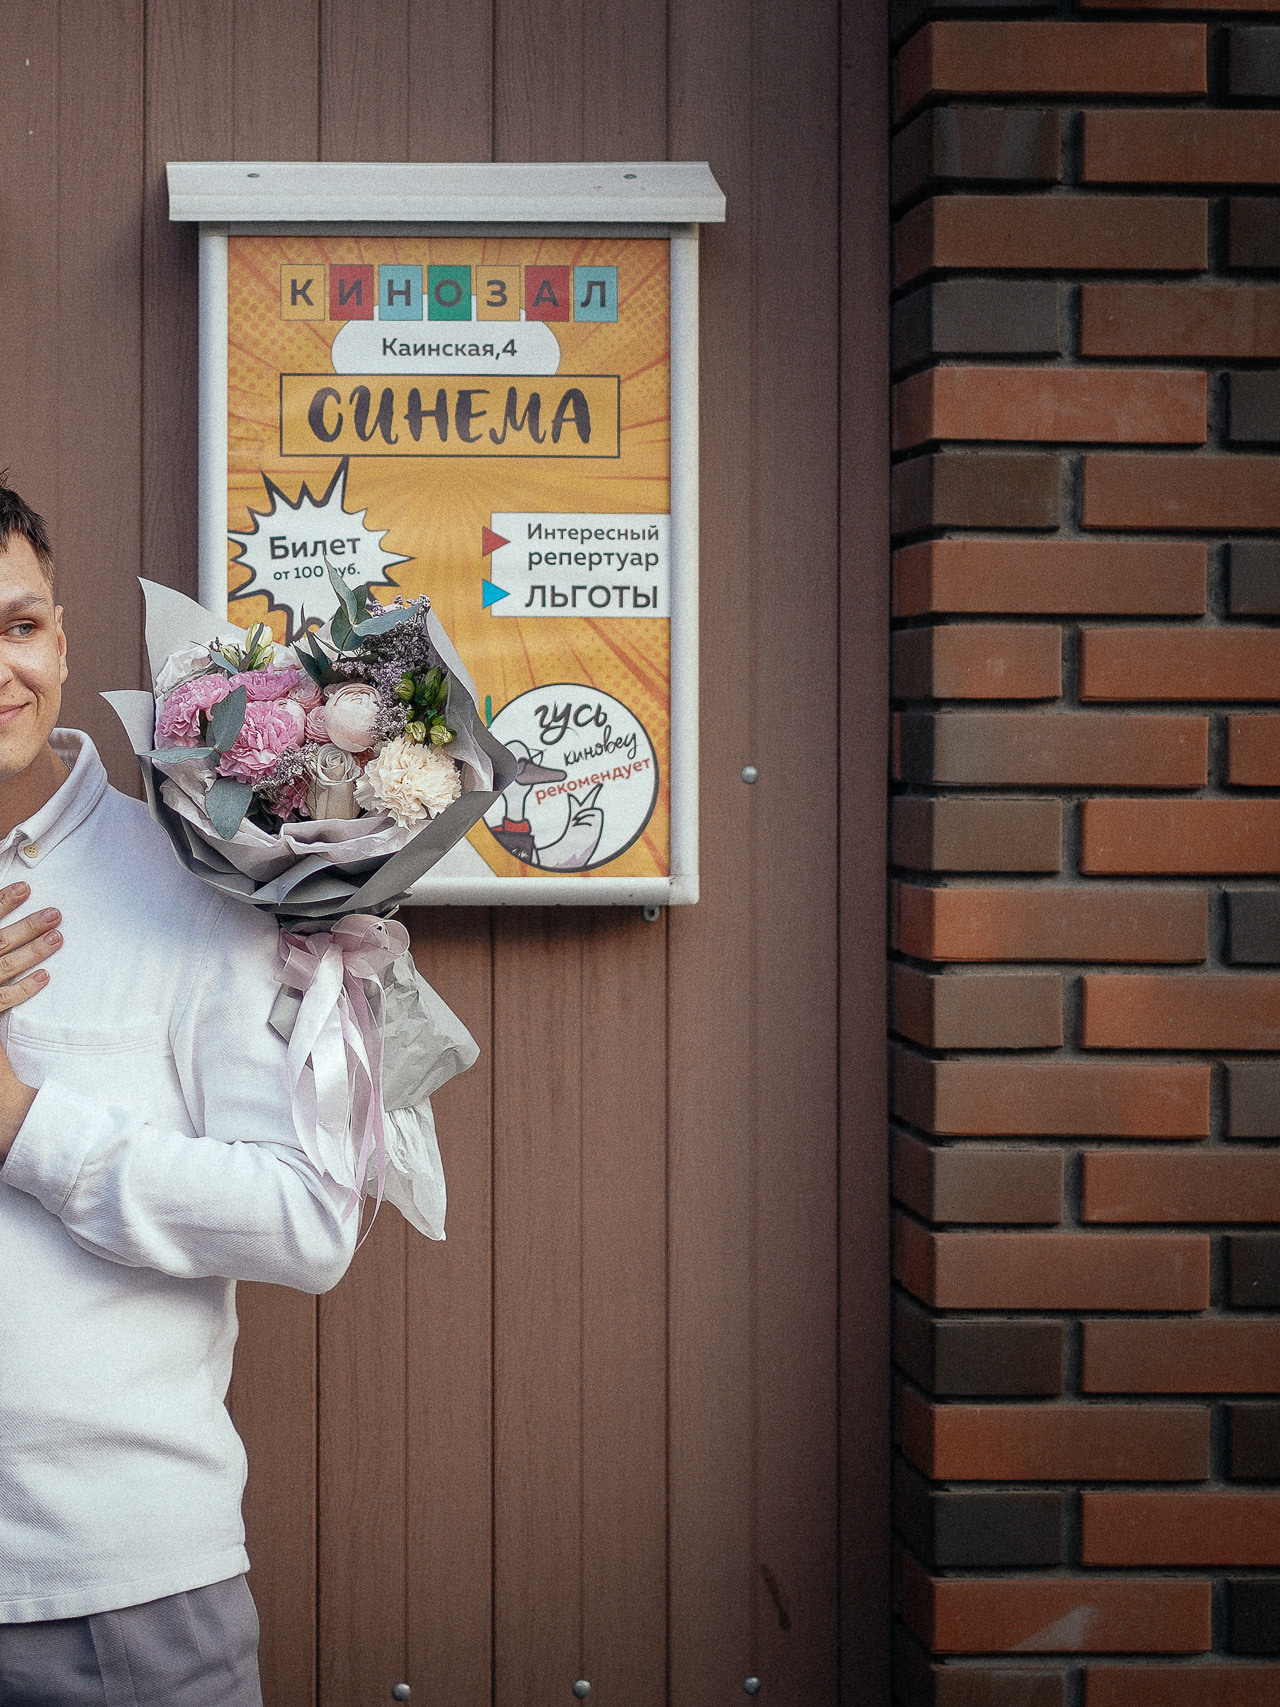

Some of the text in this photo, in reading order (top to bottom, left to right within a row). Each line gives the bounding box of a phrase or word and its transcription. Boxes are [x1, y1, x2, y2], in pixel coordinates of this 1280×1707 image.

[290, 278, 607, 310] КИНОЗАЛ
[381, 337, 518, 360] Каинская,4
[307, 385, 592, 446] СИНЕМА
[527, 523, 659, 544] Интересный
[269, 535, 361, 560] Билет
[273, 562, 360, 580] от 100 уб.
[528, 550, 659, 571] репертуар
[525, 585, 658, 609] ЛЬГОТЫ
[534, 758, 651, 805] рекомендует
